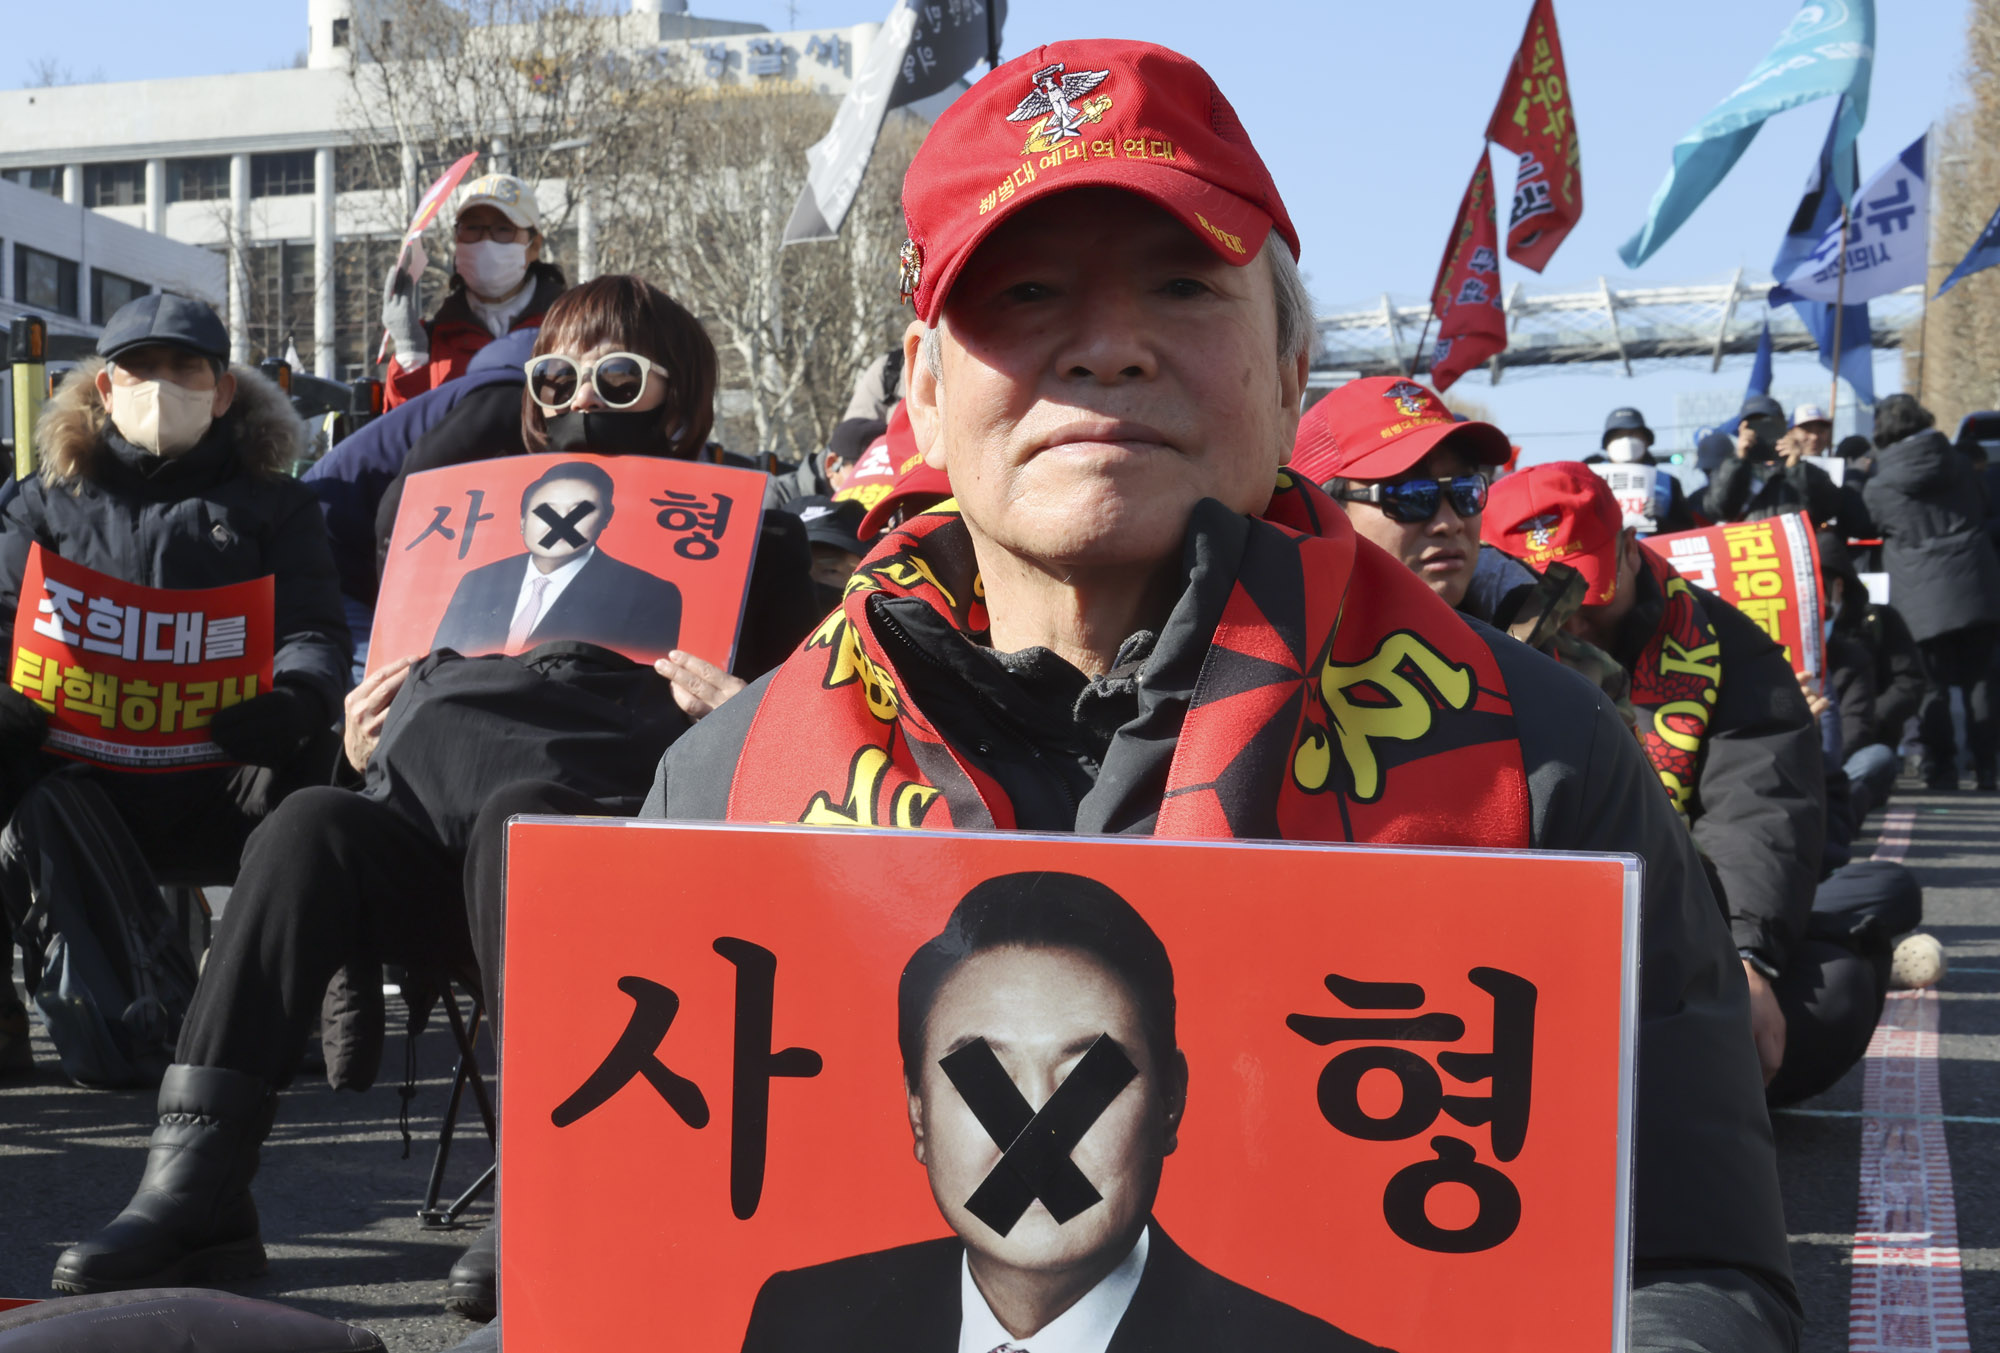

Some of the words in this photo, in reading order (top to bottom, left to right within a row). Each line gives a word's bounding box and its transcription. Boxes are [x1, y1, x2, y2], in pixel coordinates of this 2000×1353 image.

[979, 160, 1037, 216] 해병대
[1039, 137, 1117, 172] 예비역
[1122, 137, 1177, 162] 연대
[405, 489, 495, 560] 사
[649, 489, 735, 561] 형
[33, 577, 247, 665] 조희대를
[550, 935, 824, 1221] 사
[1285, 965, 1539, 1254] 형
